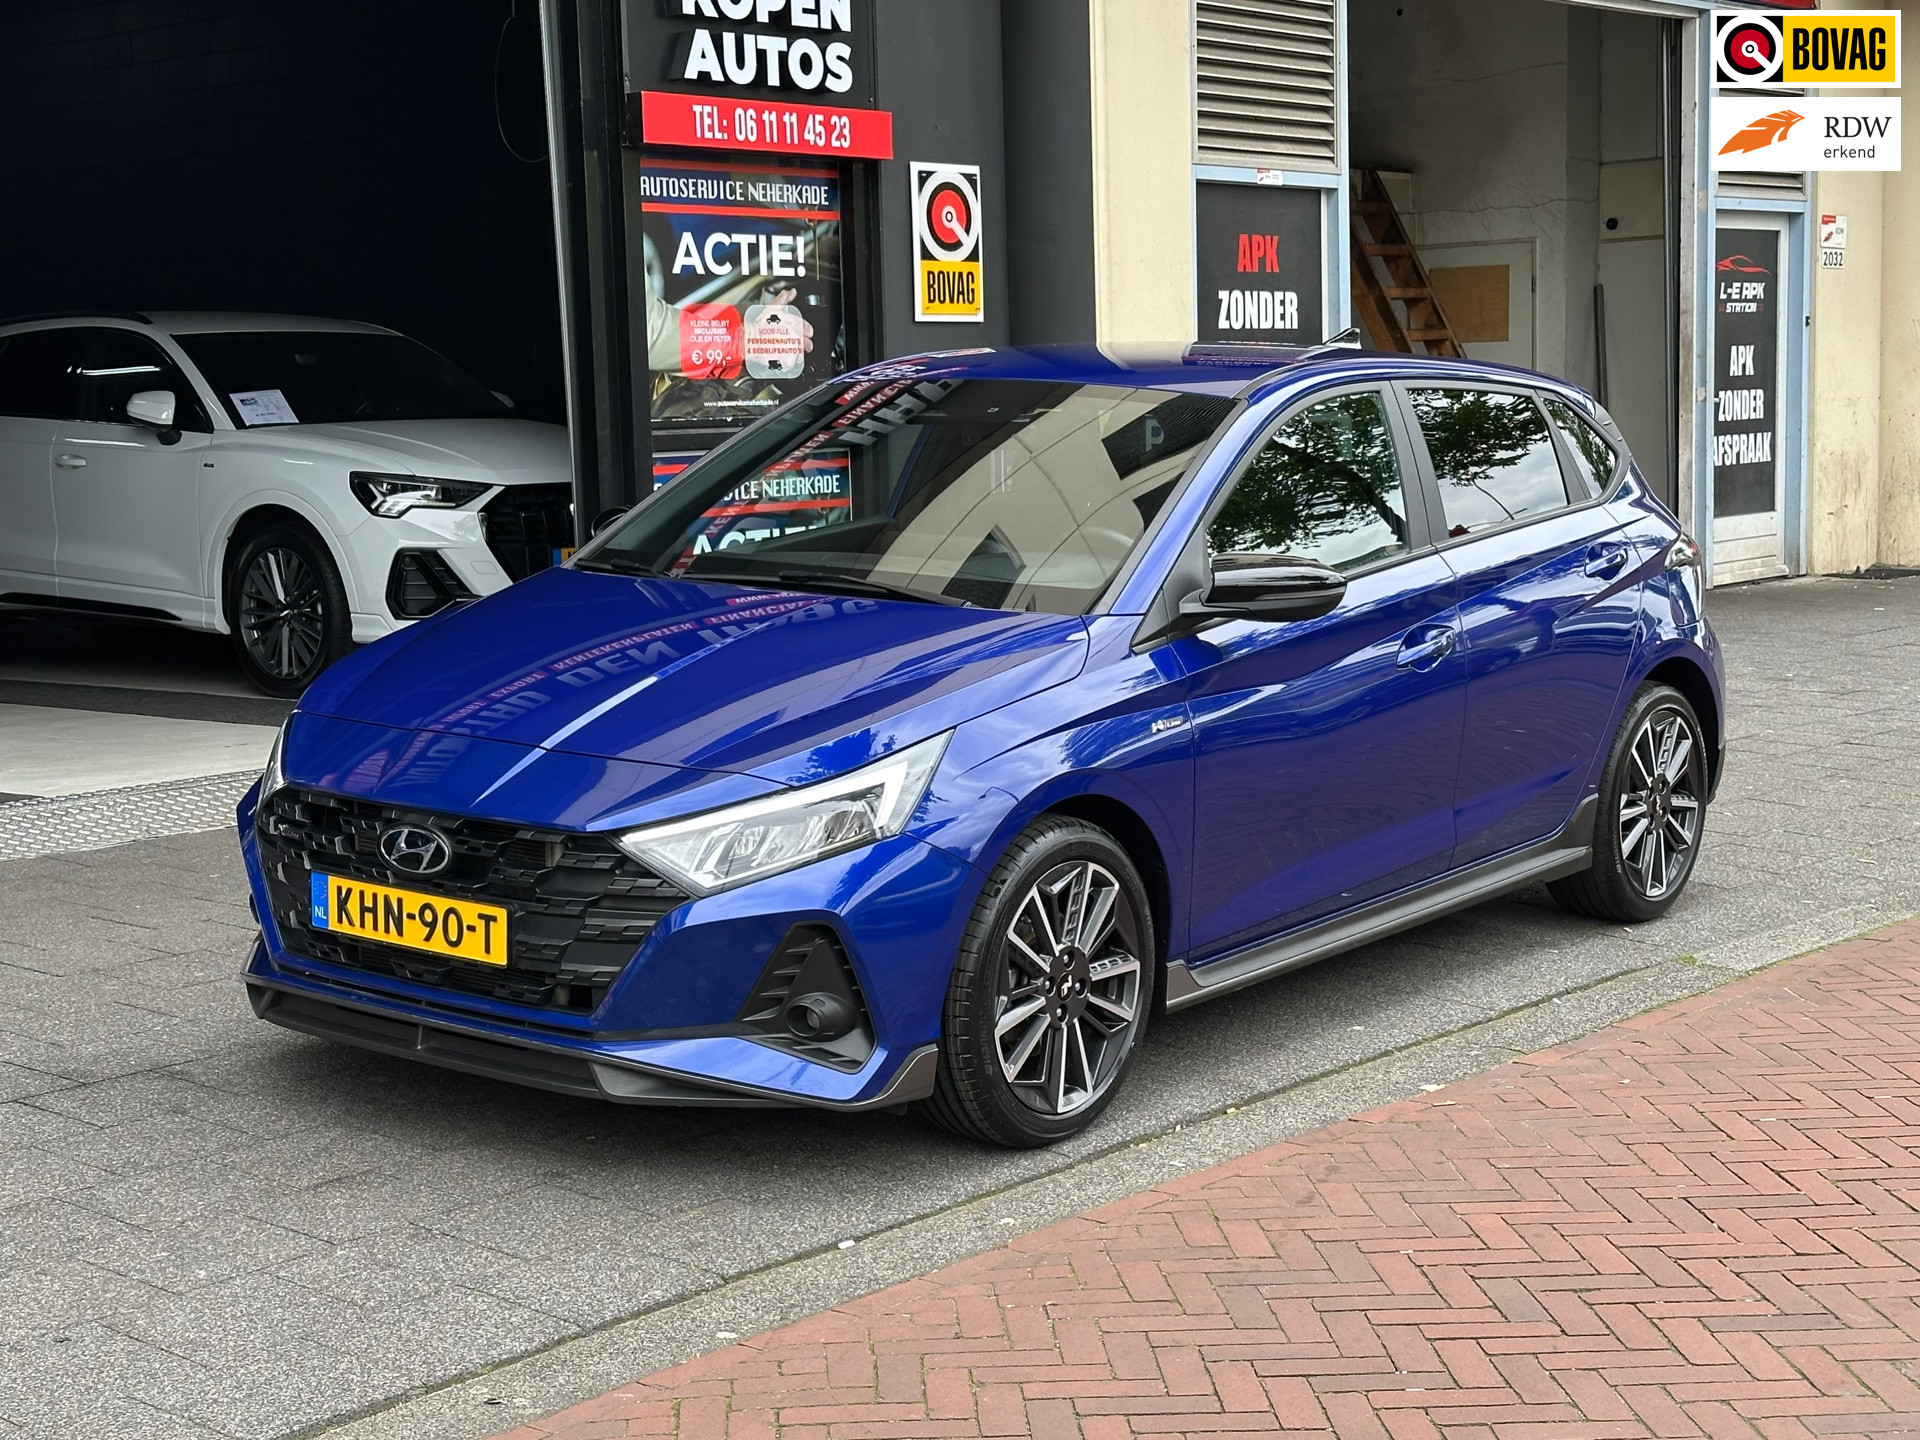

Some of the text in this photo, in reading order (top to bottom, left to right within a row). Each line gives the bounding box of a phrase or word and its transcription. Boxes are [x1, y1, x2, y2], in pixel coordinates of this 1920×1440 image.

[684, 28, 853, 93] AUTOS
[692, 104, 851, 148] TEL: 06 11 11 45 23
[640, 175, 829, 205] AUTOSERVICE NEHERKADE
[672, 231, 807, 278] ACTIE!
[1237, 233, 1280, 273] APK
[1823, 251, 1844, 267] 2032
[926, 270, 975, 305] BOVAG
[1720, 282, 1765, 300] L-E APK
[1218, 290, 1299, 330] ZONDER
[1725, 302, 1757, 313] STATION
[691, 349, 733, 367] € 99,-
[1729, 345, 1754, 377] APK
[1718, 389, 1764, 422] ZONDER
[762, 474, 840, 498] NEHERKADE
[315, 910, 327, 919] NL
[336, 885, 498, 955] KHN-90-T
